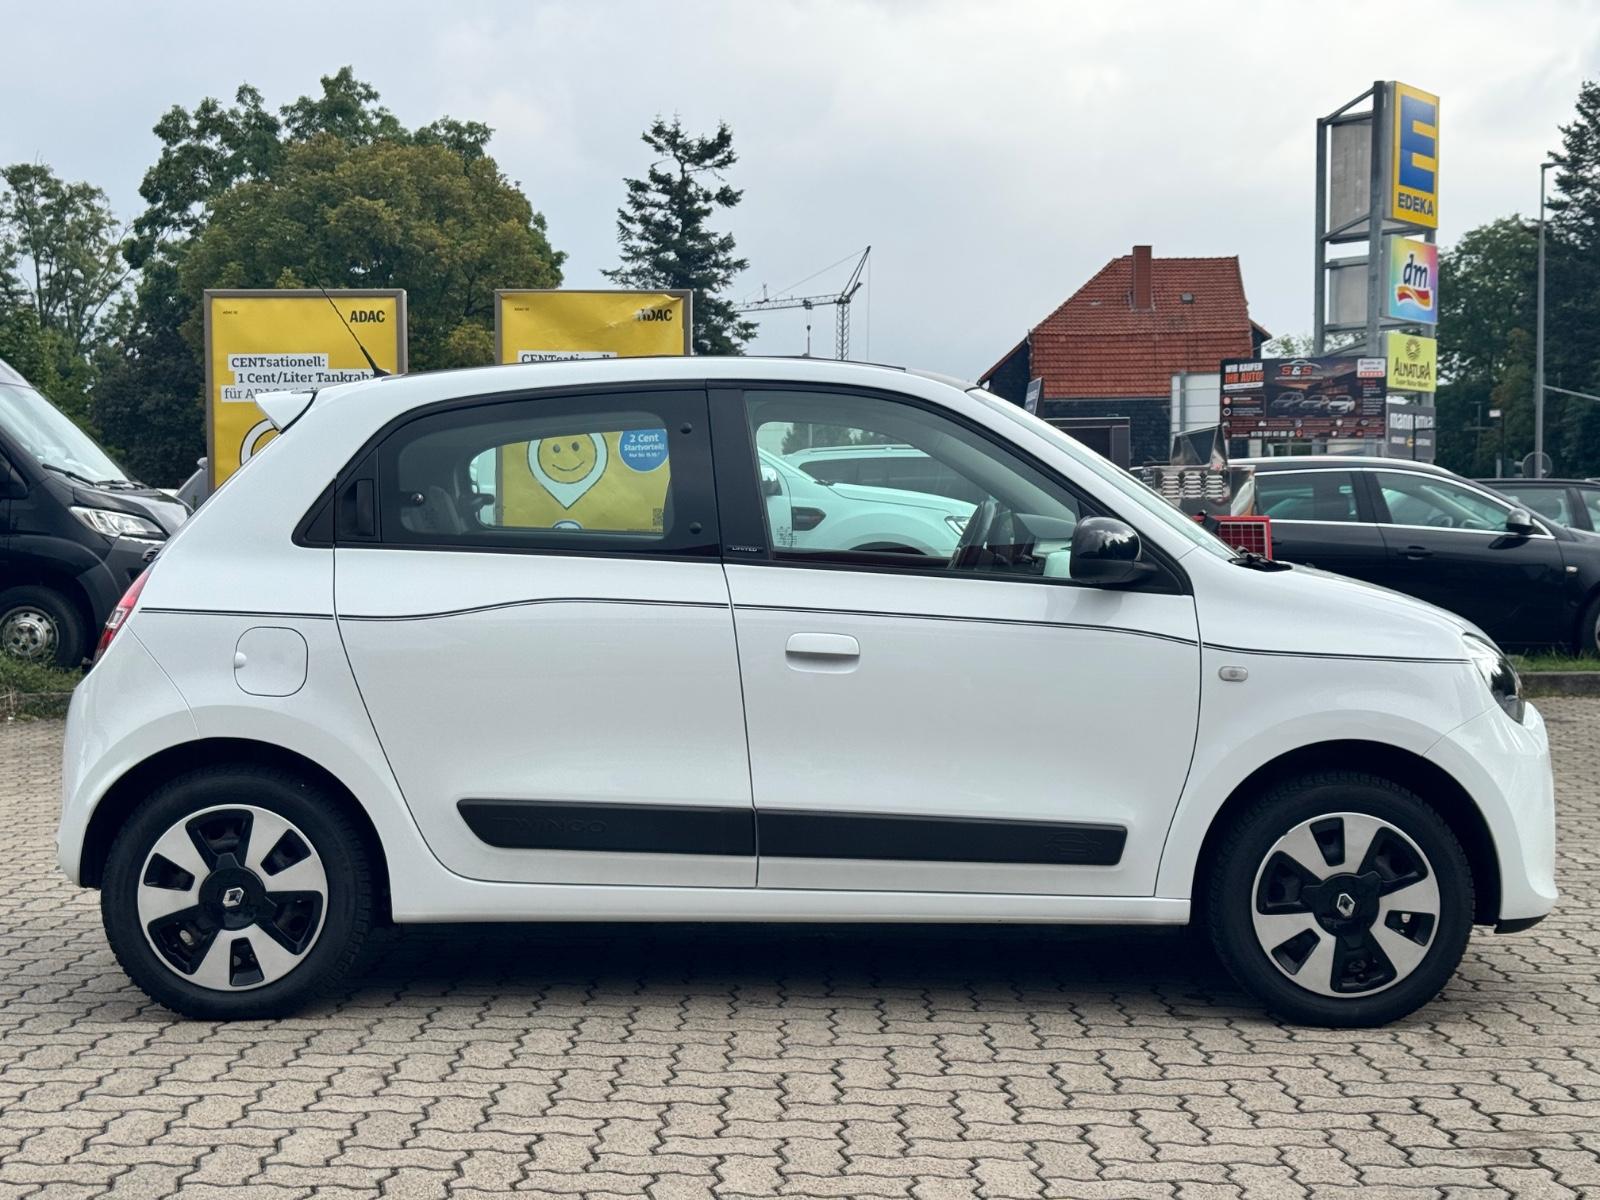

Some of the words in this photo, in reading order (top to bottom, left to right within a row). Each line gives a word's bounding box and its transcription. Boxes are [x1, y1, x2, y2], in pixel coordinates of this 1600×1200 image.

[1398, 192, 1434, 216] EDEKA
[1403, 253, 1428, 289] dm
[350, 310, 386, 323] ADAC
[231, 356, 326, 368] CENTsationell:
[1281, 366, 1313, 376] S&S
[1393, 357, 1431, 380] ALNATURA
[238, 373, 244, 383] 1
[247, 372, 312, 384] Cent/Liter
[316, 372, 374, 384] Tankrab
[225, 388, 245, 398] für
[629, 434, 636, 443] 2
[638, 433, 660, 443] Cent
[624, 443, 665, 452] Startvorteil!
